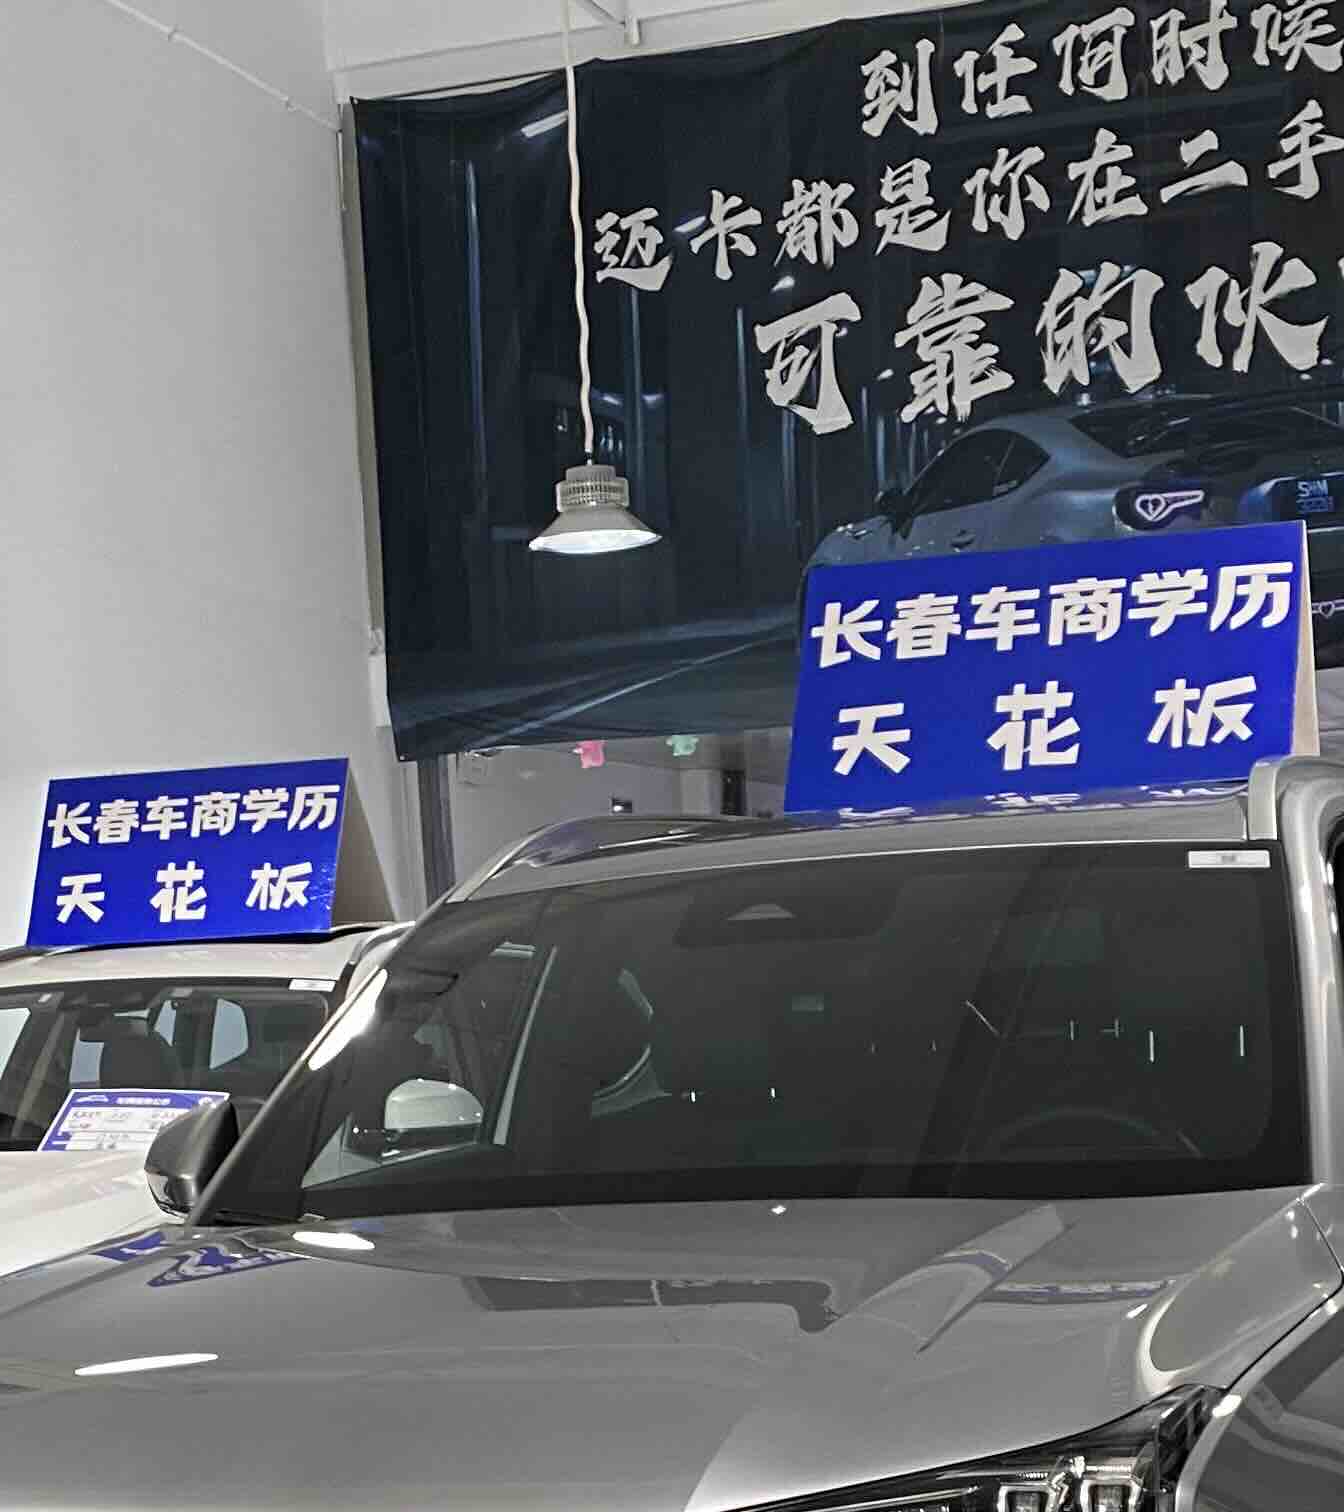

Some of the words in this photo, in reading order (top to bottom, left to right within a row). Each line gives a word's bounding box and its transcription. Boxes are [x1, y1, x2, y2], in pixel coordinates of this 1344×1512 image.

[811, 561, 1294, 669] 长春车商学历
[831, 675, 1257, 775] 天花板
[48, 784, 341, 848] 长春车商学历
[56, 861, 313, 924] 天花板
